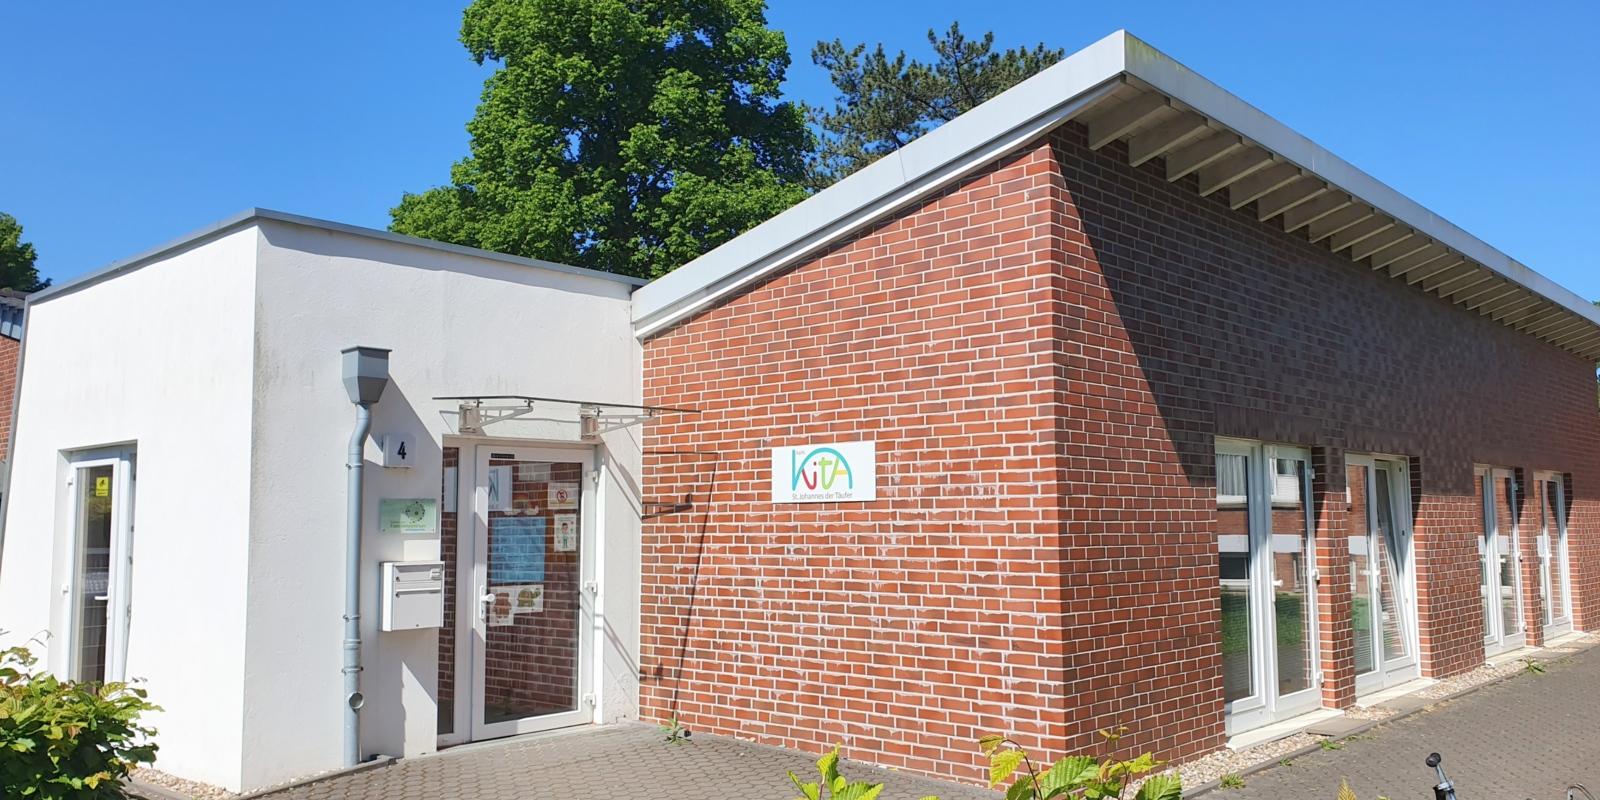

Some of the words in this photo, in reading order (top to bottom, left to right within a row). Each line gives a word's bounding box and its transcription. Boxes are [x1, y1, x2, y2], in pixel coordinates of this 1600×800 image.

[397, 441, 407, 460] 4
[799, 492, 824, 500] Johannes
[835, 491, 852, 499] Täufer
